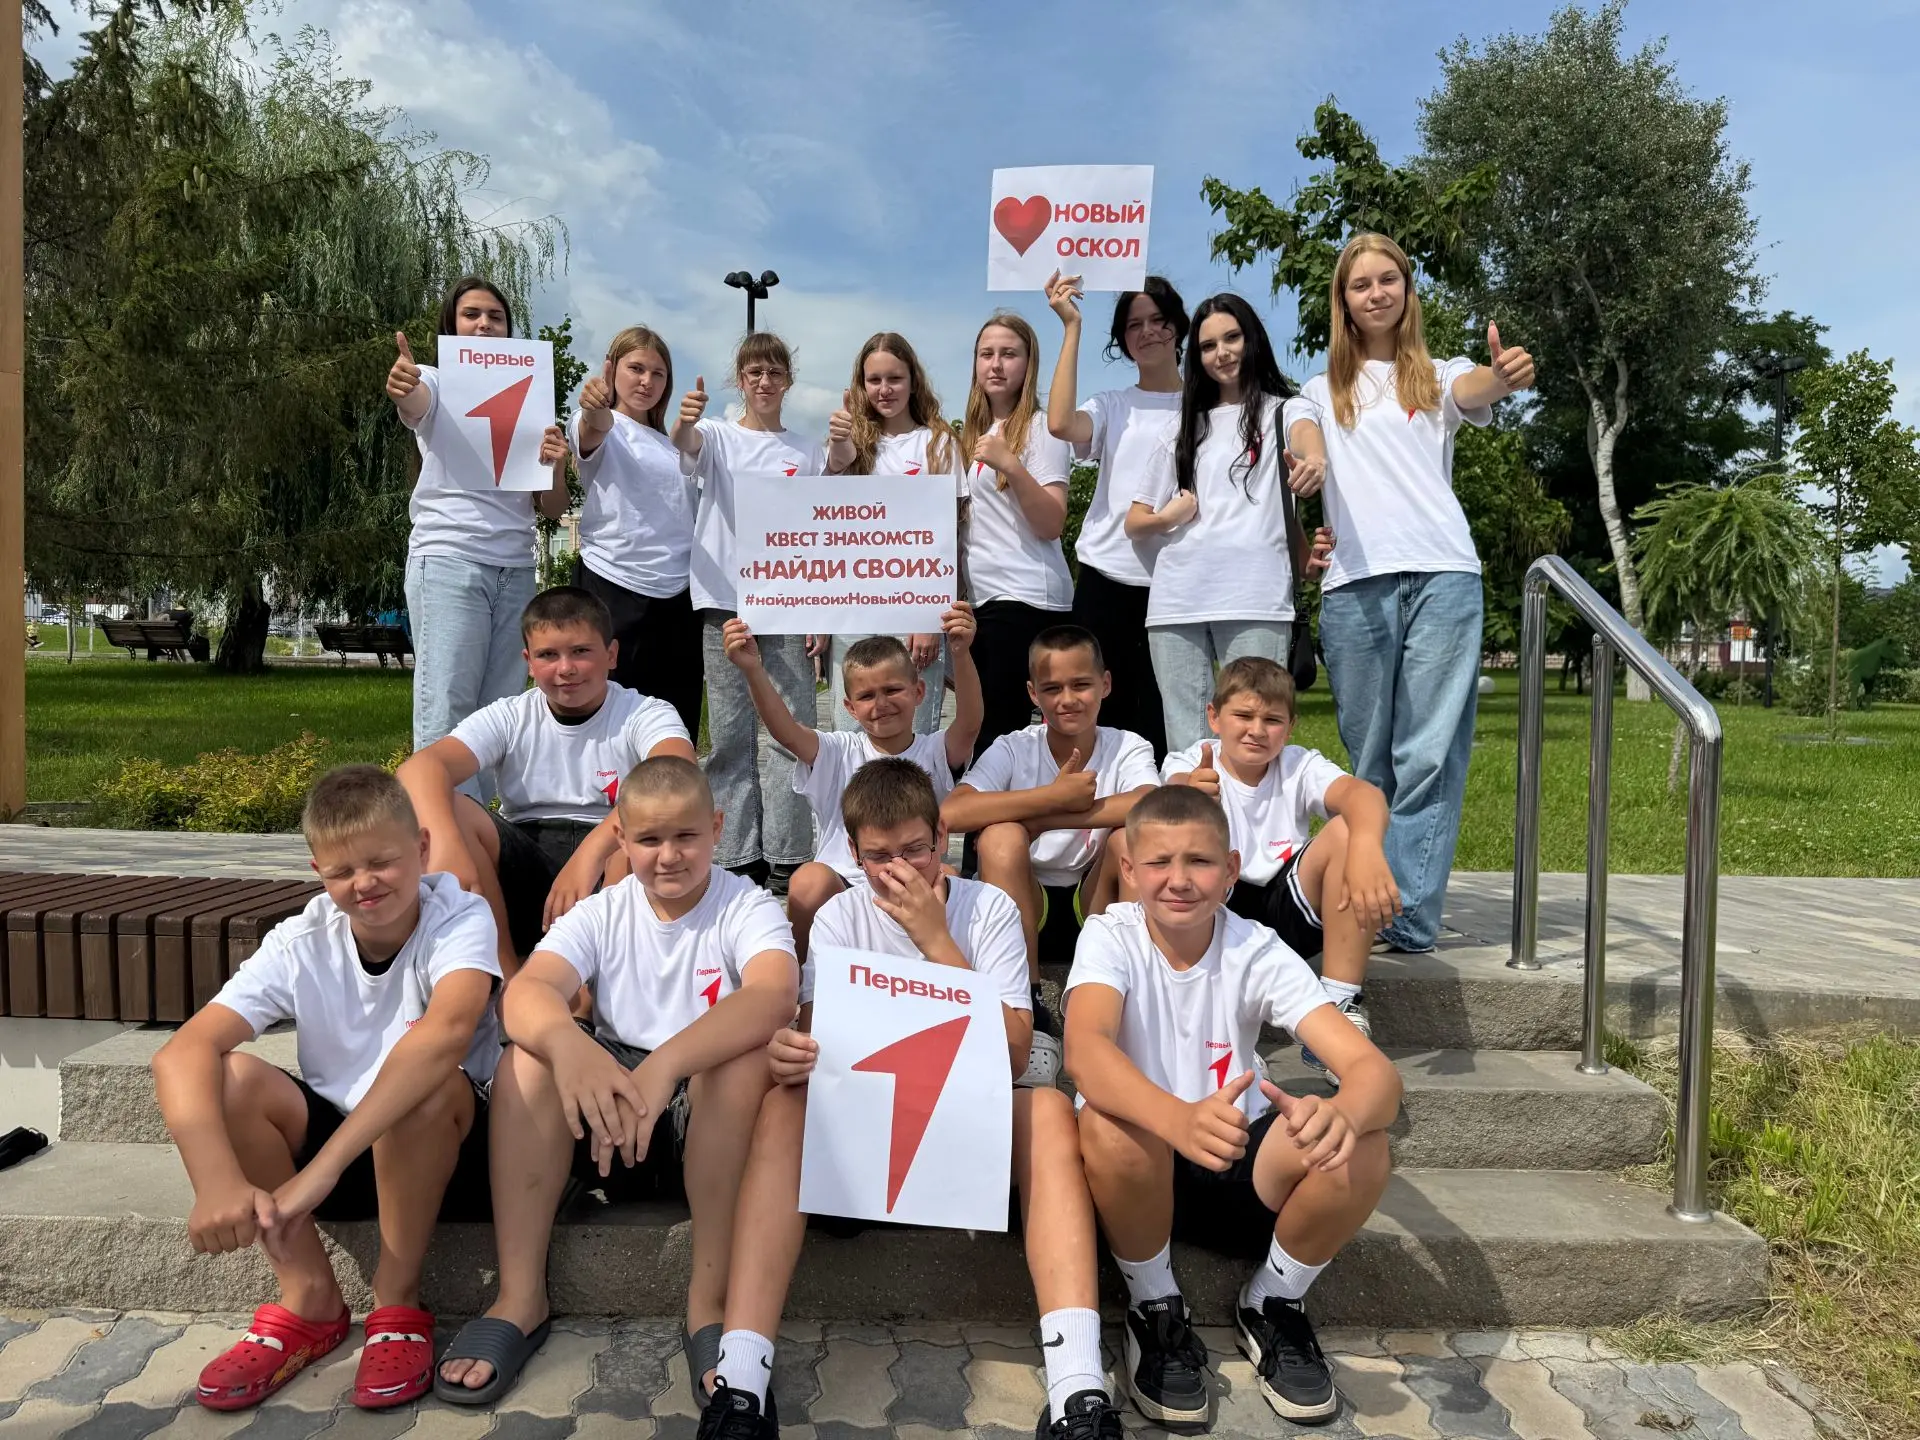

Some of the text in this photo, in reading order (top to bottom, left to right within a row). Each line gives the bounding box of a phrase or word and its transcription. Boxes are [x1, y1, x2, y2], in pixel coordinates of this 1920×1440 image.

[1054, 199, 1145, 224] НОВЫЙ
[1056, 237, 1140, 258] ОСКОЛ
[458, 348, 535, 369] Первые
[813, 502, 886, 520] ЖИВОЙ
[766, 530, 934, 547] КВЕСТ ЗНАКОМСТВ
[739, 555, 955, 582] «НАЙДИ СВОИХ»
[745, 591, 950, 608] #найдисвоихНовыйОскол
[849, 964, 972, 1005] Первые
